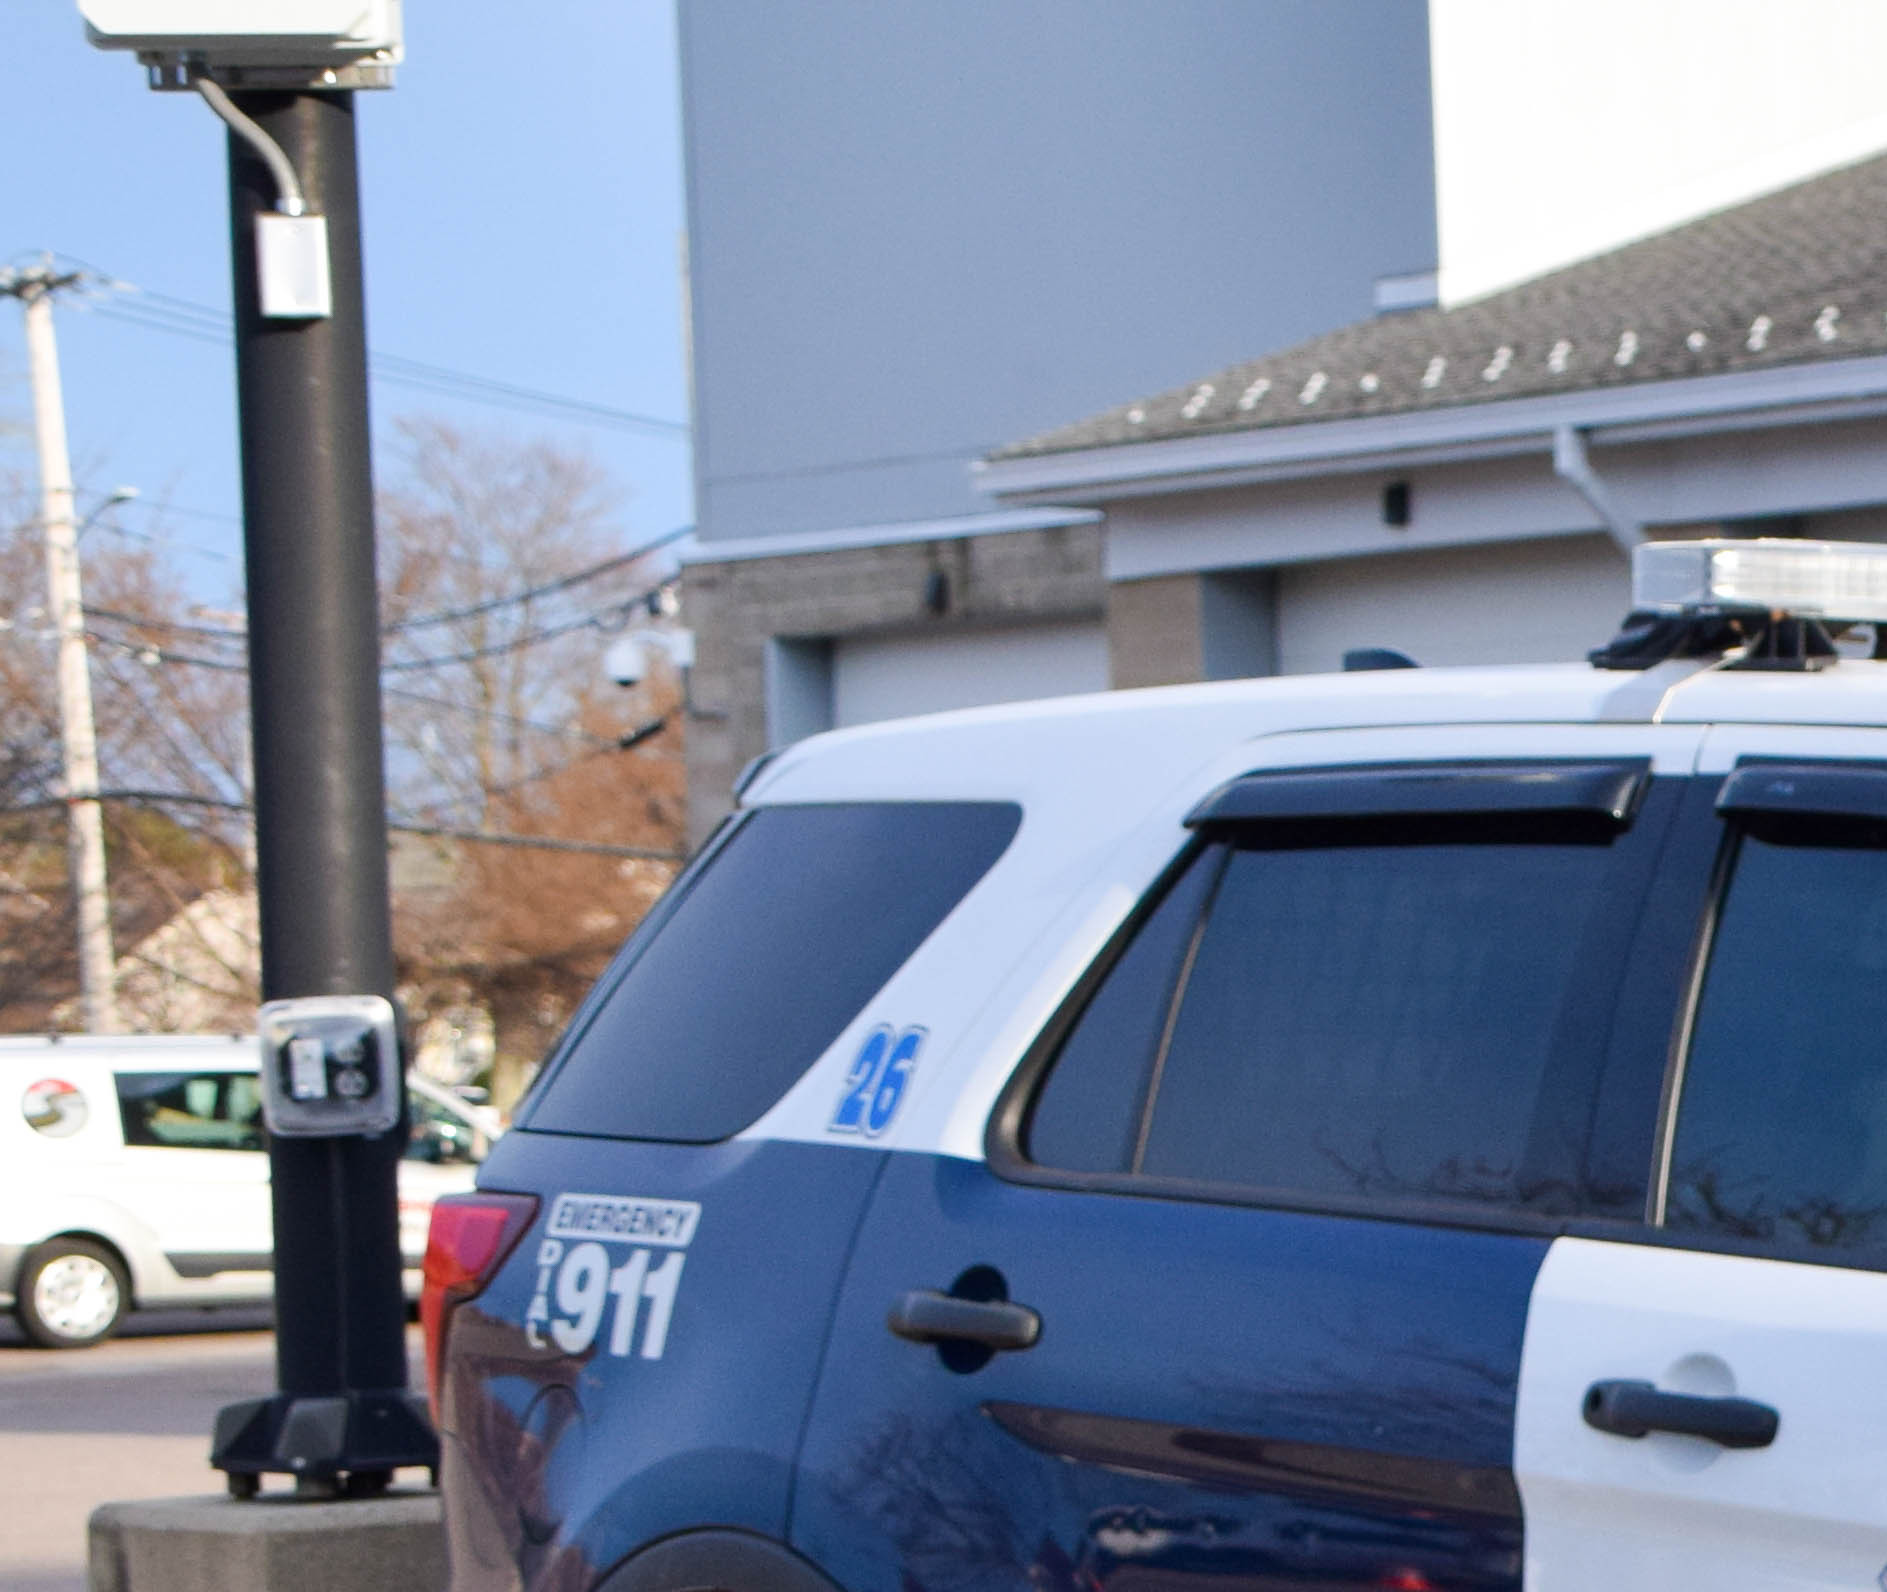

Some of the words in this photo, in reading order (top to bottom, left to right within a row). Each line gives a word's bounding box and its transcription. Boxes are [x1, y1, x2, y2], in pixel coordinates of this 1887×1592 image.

[826, 1022, 929, 1138] 26
[556, 1201, 690, 1238] EMERGENCY
[525, 1239, 564, 1349] DIAL
[550, 1242, 686, 1359] 911
